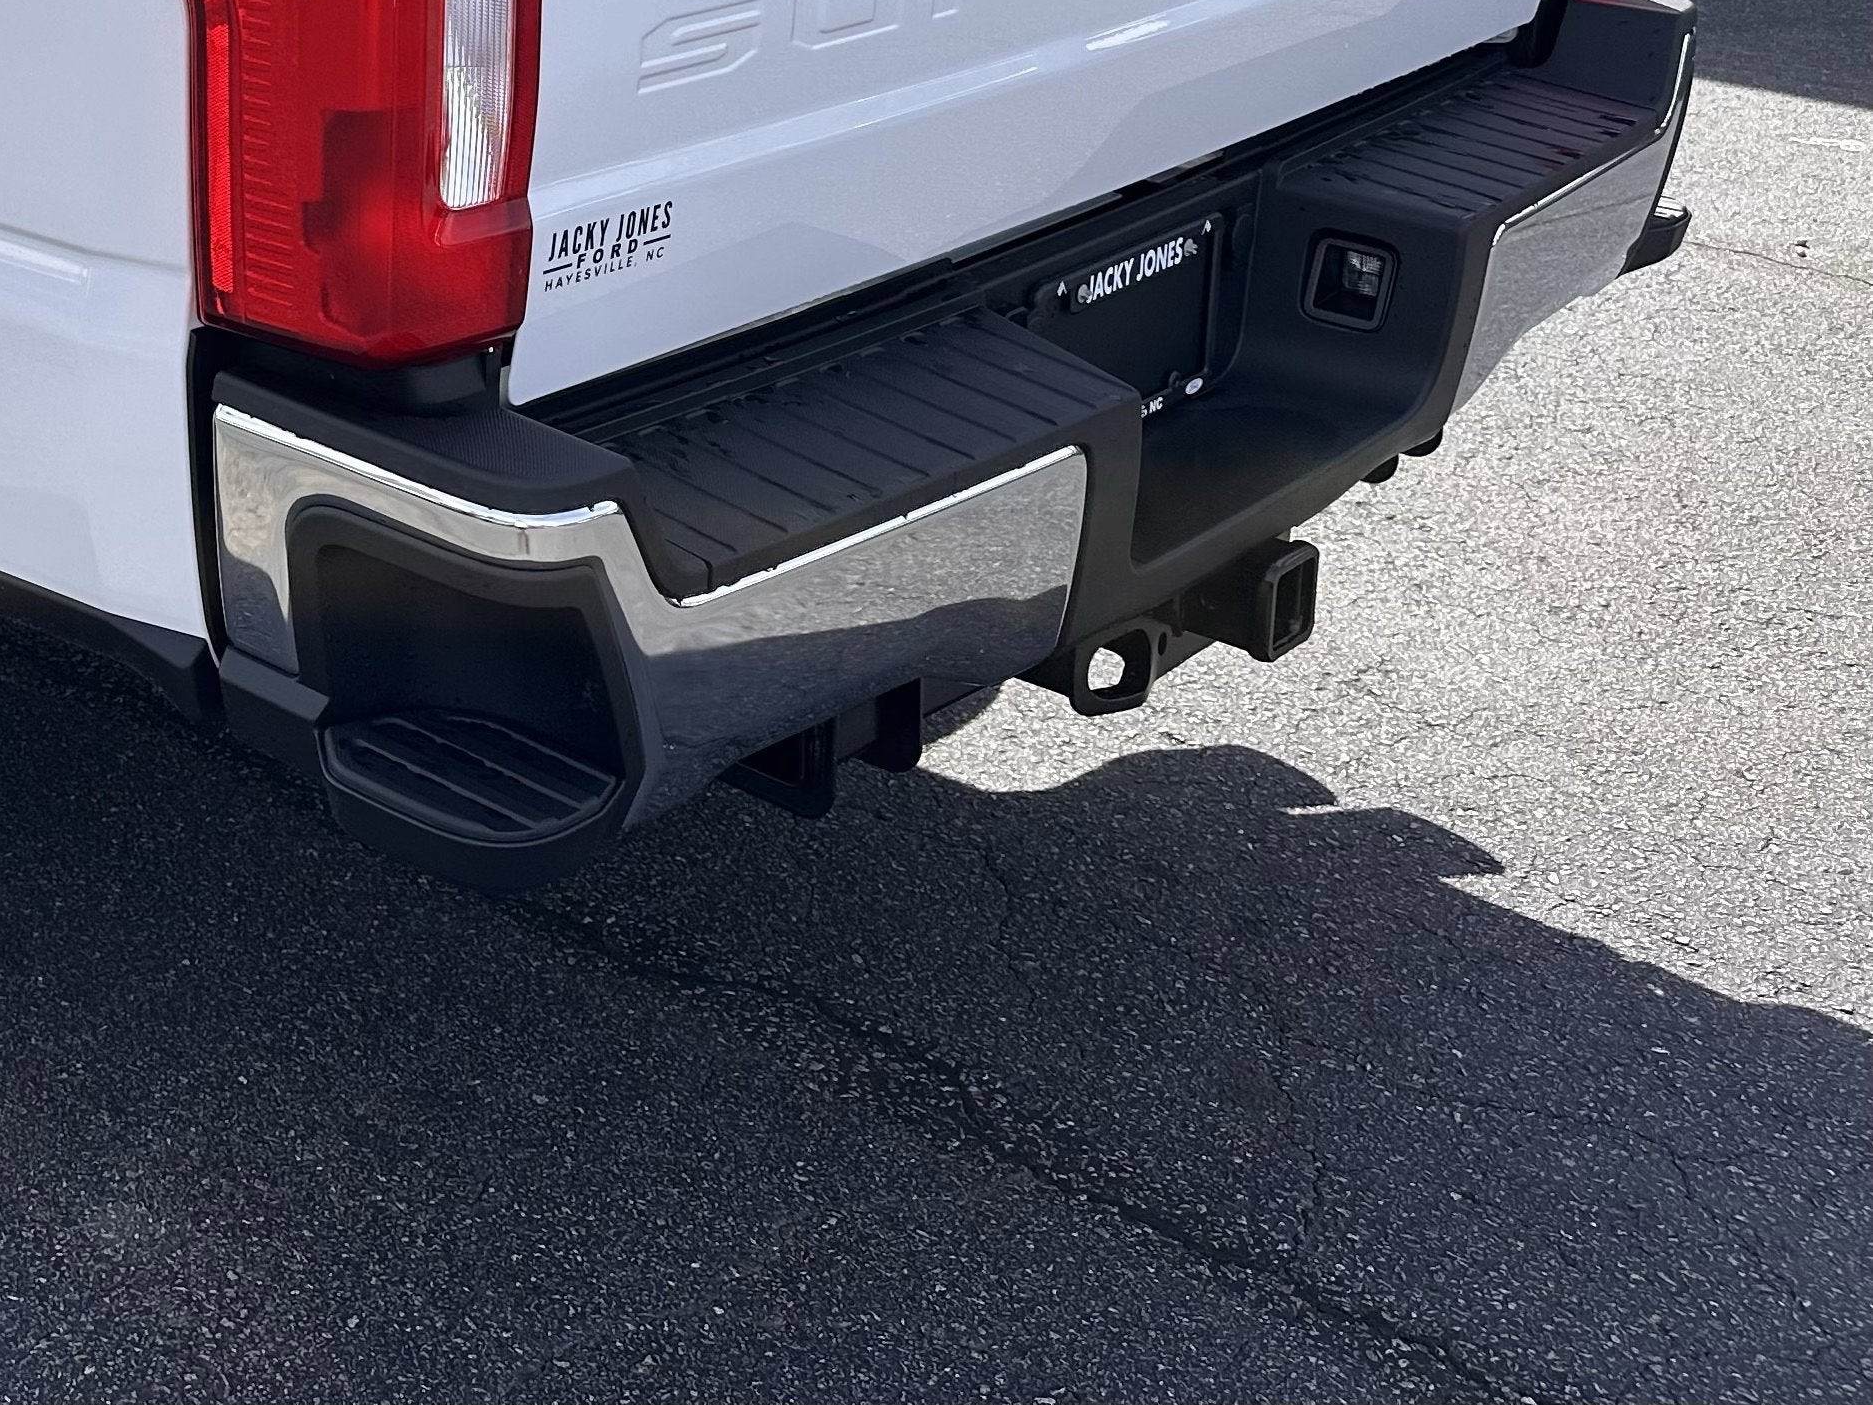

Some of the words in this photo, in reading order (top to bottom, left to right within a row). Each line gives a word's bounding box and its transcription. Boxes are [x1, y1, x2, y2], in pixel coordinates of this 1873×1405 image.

[548, 218, 610, 262] JACKY
[616, 200, 673, 242] JONES
[576, 238, 639, 269] FORD
[646, 247, 665, 262] NC
[1086, 257, 1135, 303] JACKY
[1135, 237, 1184, 282] JONES
[1149, 396, 1164, 414] NC
